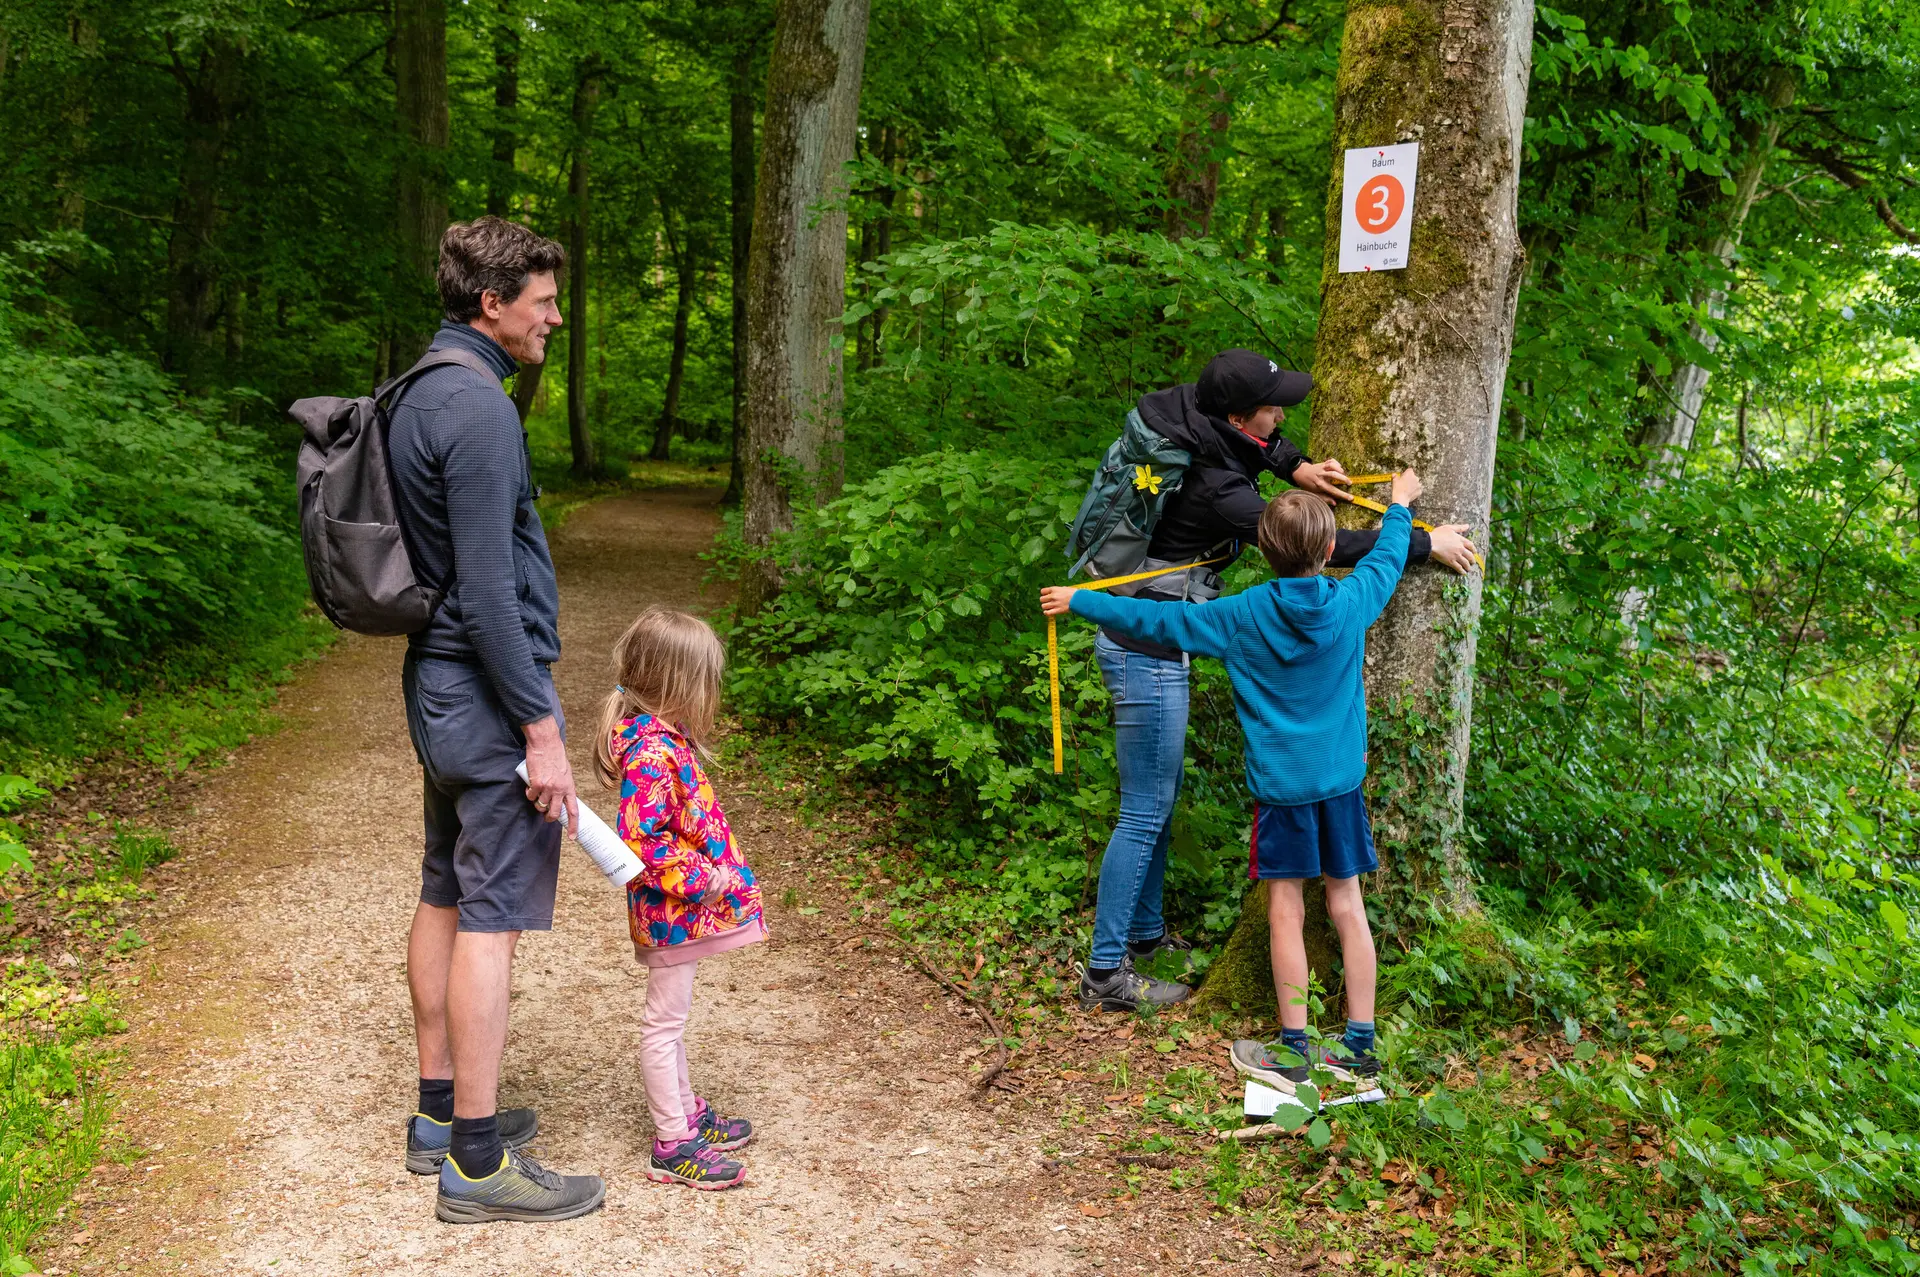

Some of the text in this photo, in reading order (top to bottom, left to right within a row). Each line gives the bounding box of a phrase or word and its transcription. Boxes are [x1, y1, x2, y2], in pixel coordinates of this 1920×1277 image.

[1371, 158, 1395, 168] Baum
[1368, 185, 1390, 226] 3
[1356, 240, 1398, 252] Hainbuche
